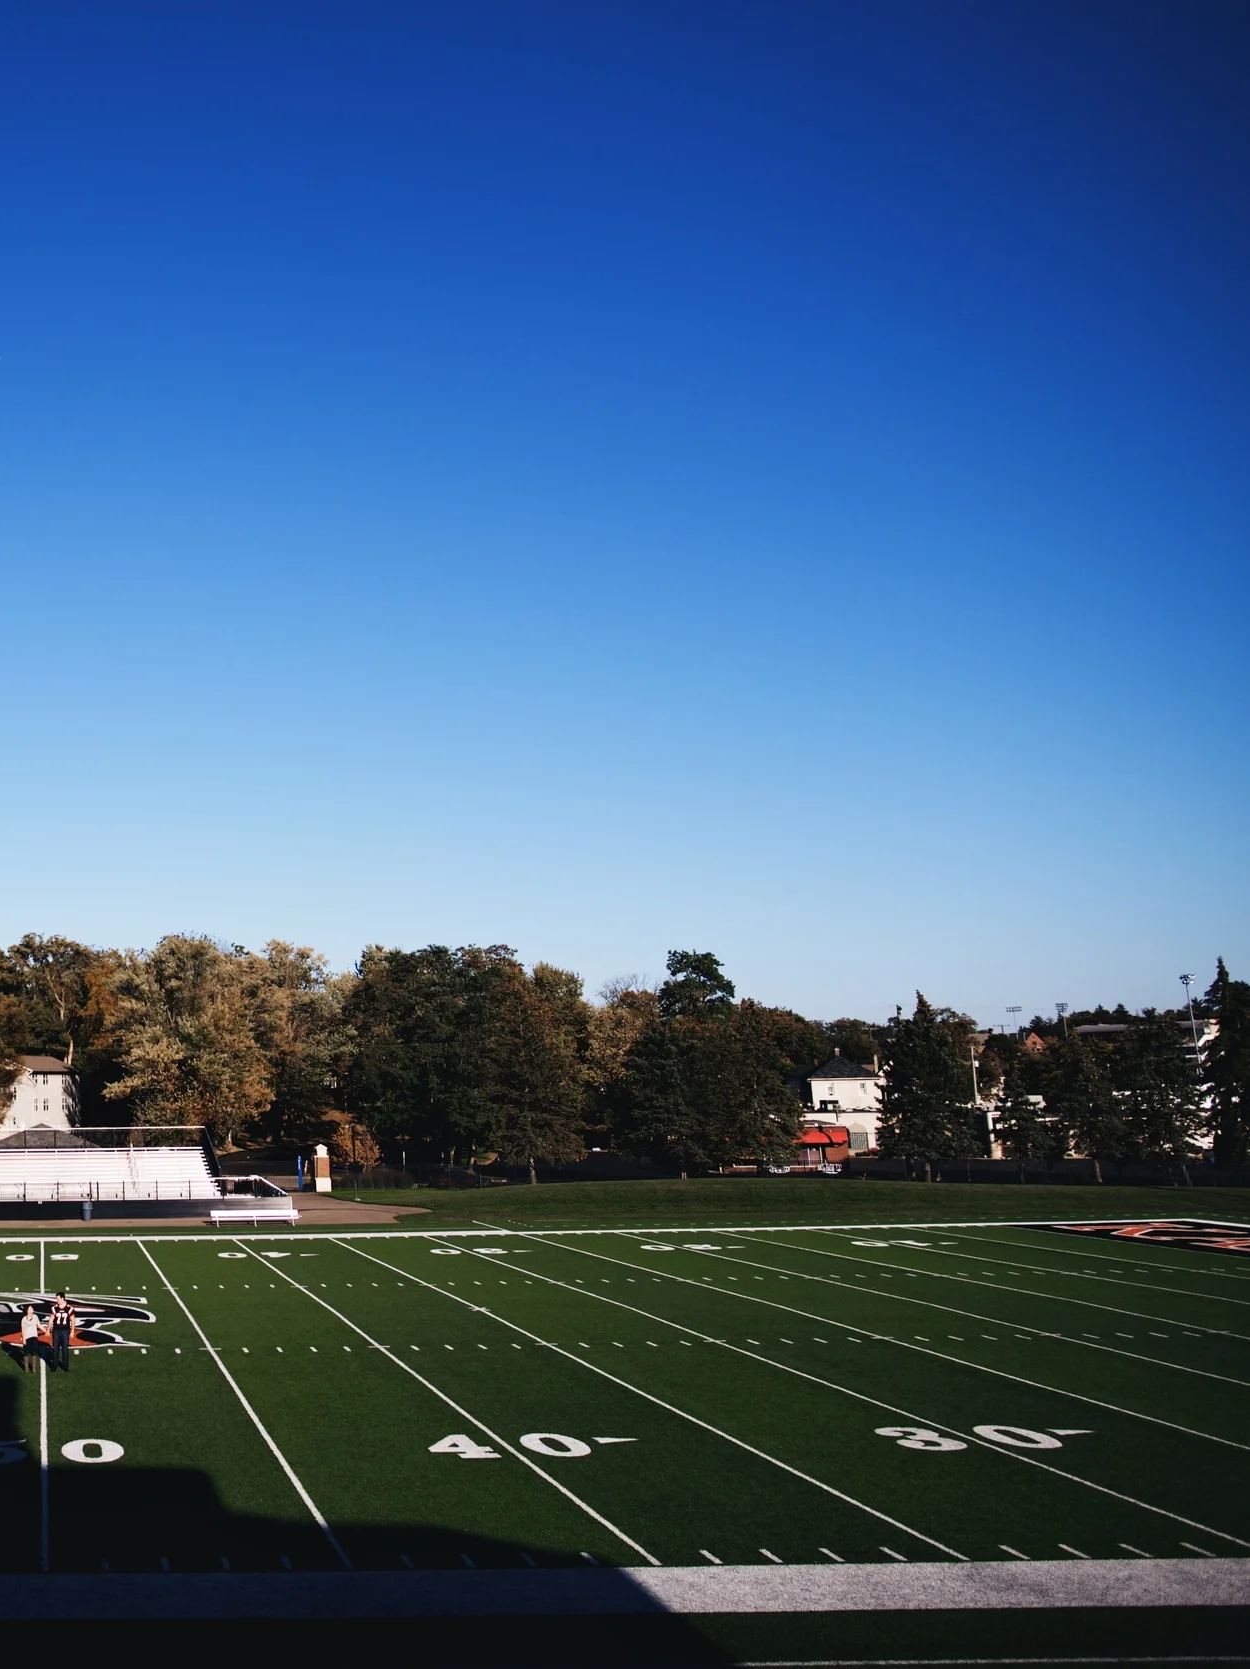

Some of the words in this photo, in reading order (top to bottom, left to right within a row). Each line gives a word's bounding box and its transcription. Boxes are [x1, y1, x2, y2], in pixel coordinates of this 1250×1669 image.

[55, 1312, 68, 1325] 77
[427, 1432, 592, 1459] 40
[874, 1424, 1063, 1451] 30
